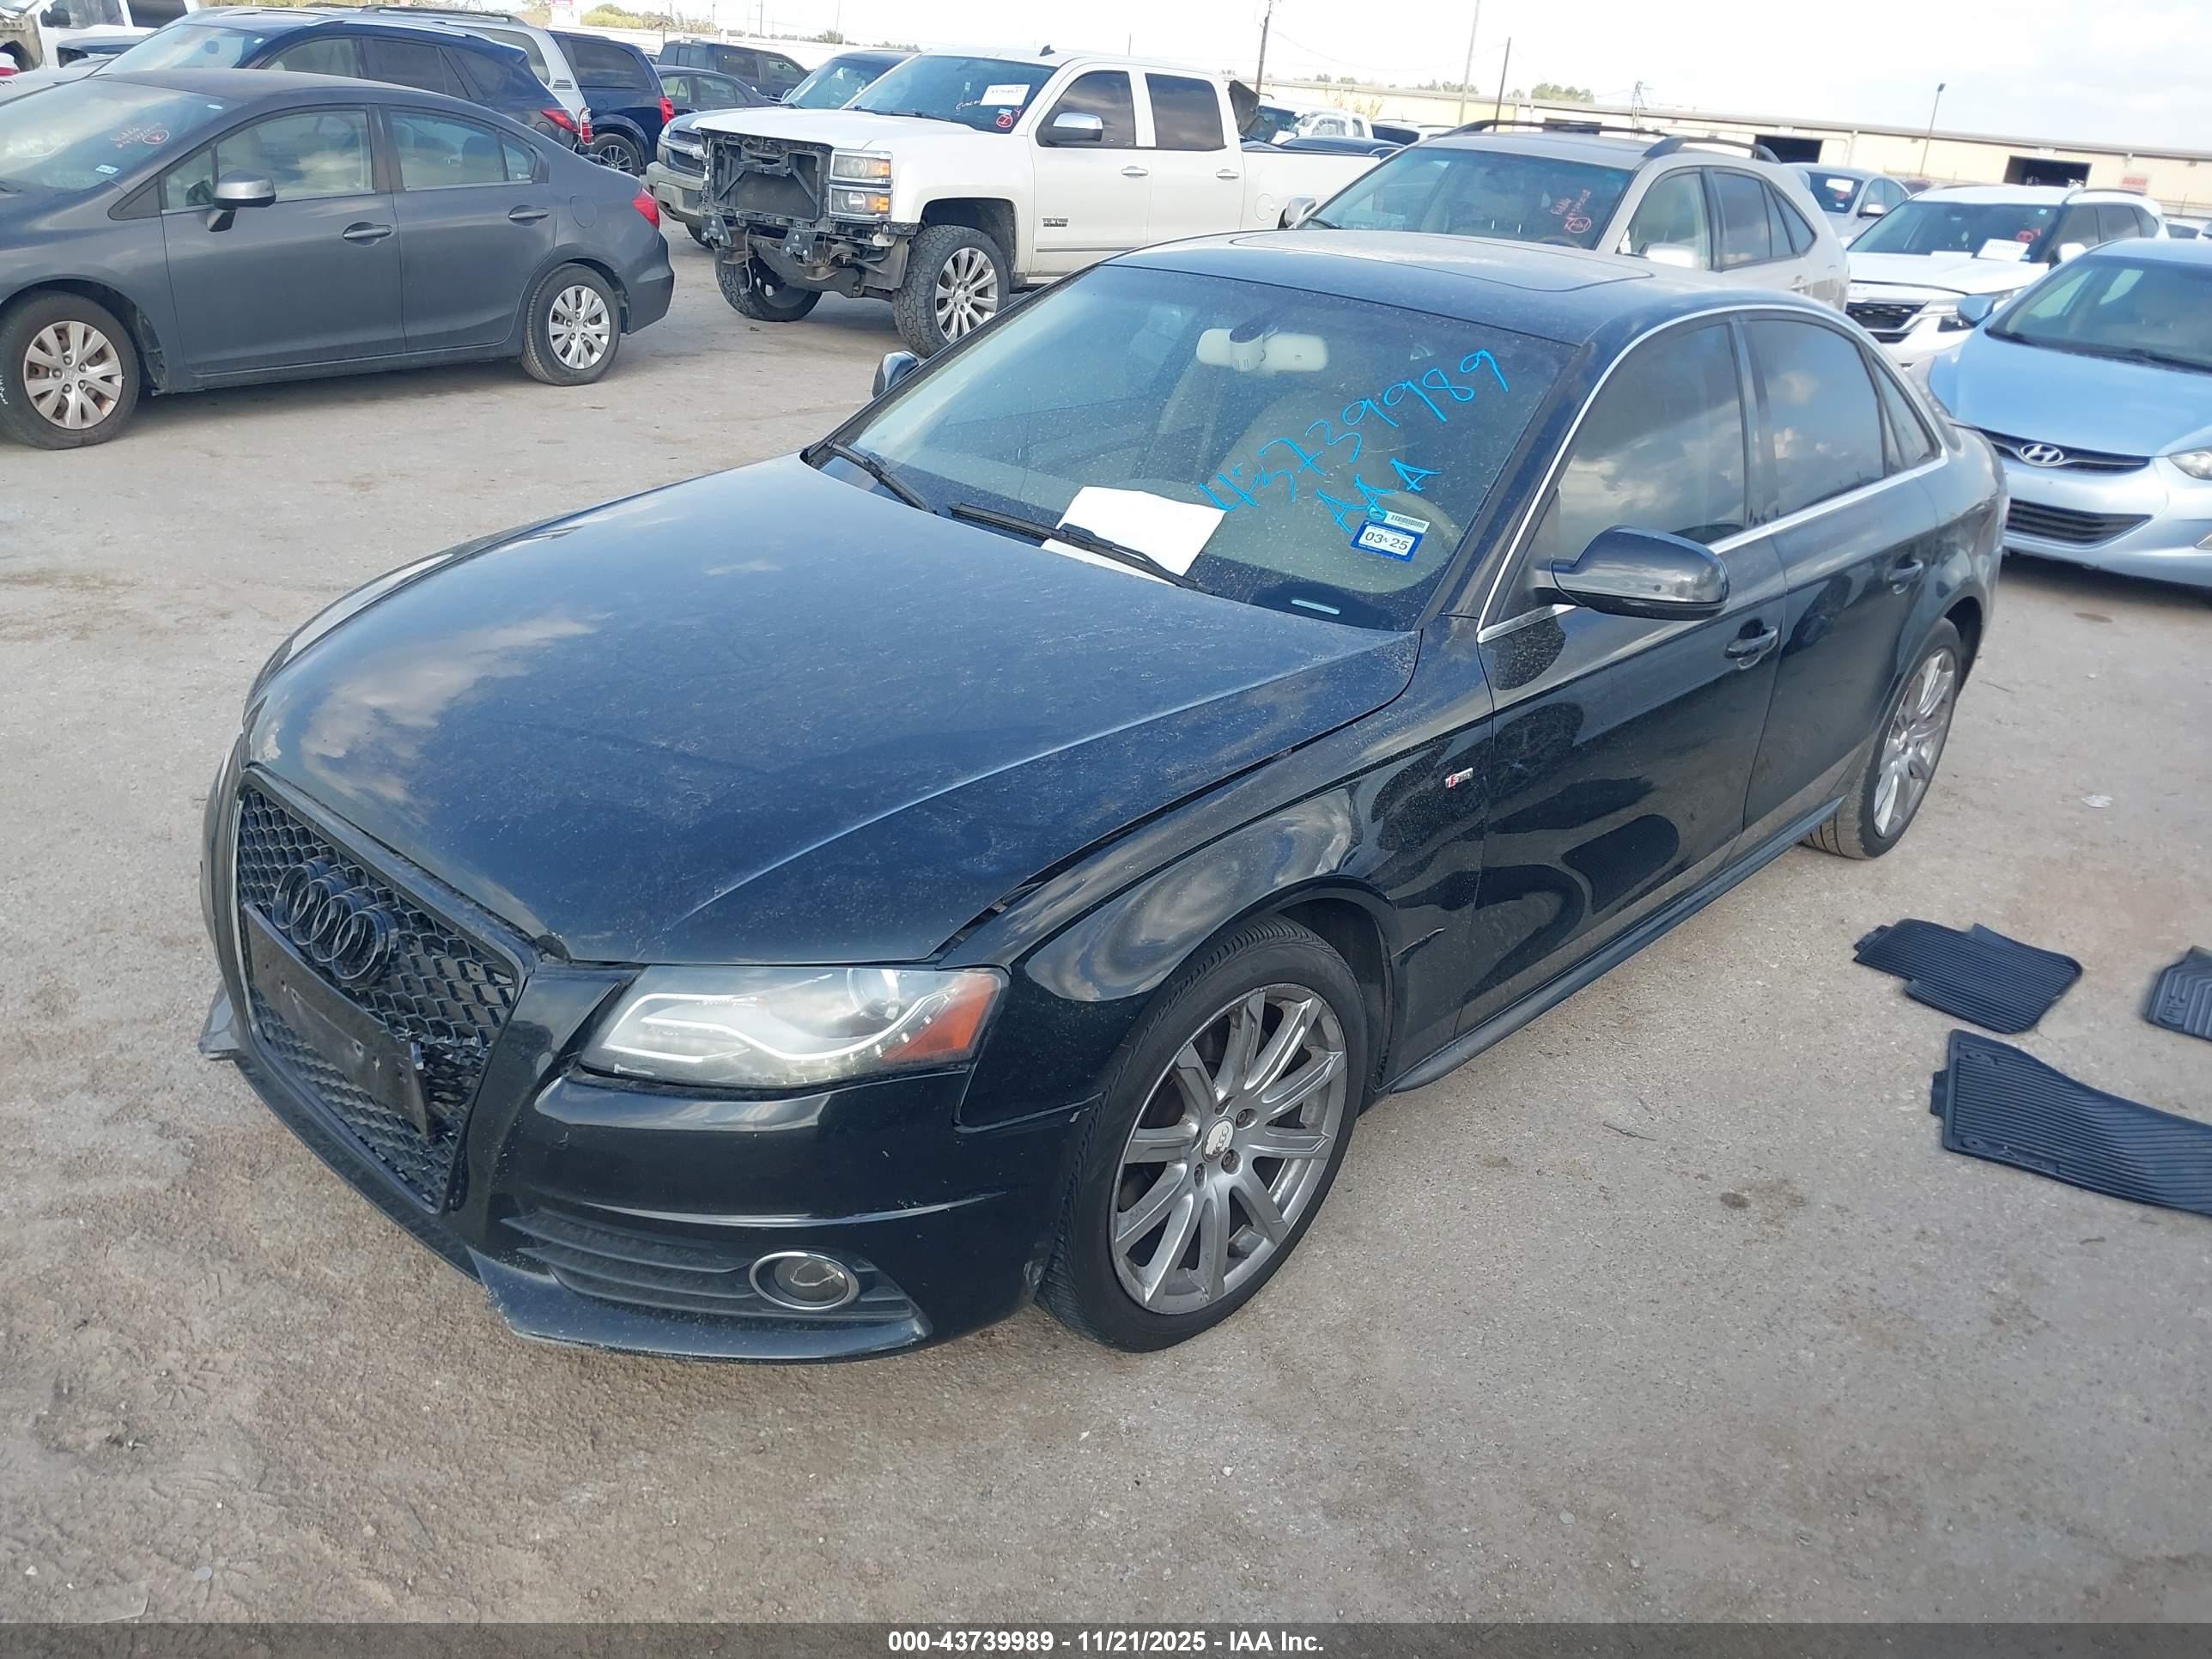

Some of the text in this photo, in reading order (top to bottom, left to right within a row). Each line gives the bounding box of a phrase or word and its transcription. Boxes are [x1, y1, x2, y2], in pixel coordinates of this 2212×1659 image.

[1199, 349, 1509, 512] 43739989
[1316, 458, 1443, 534] AAA
[1364, 532, 1384, 544] 03
[1389, 538, 1409, 550] 25
